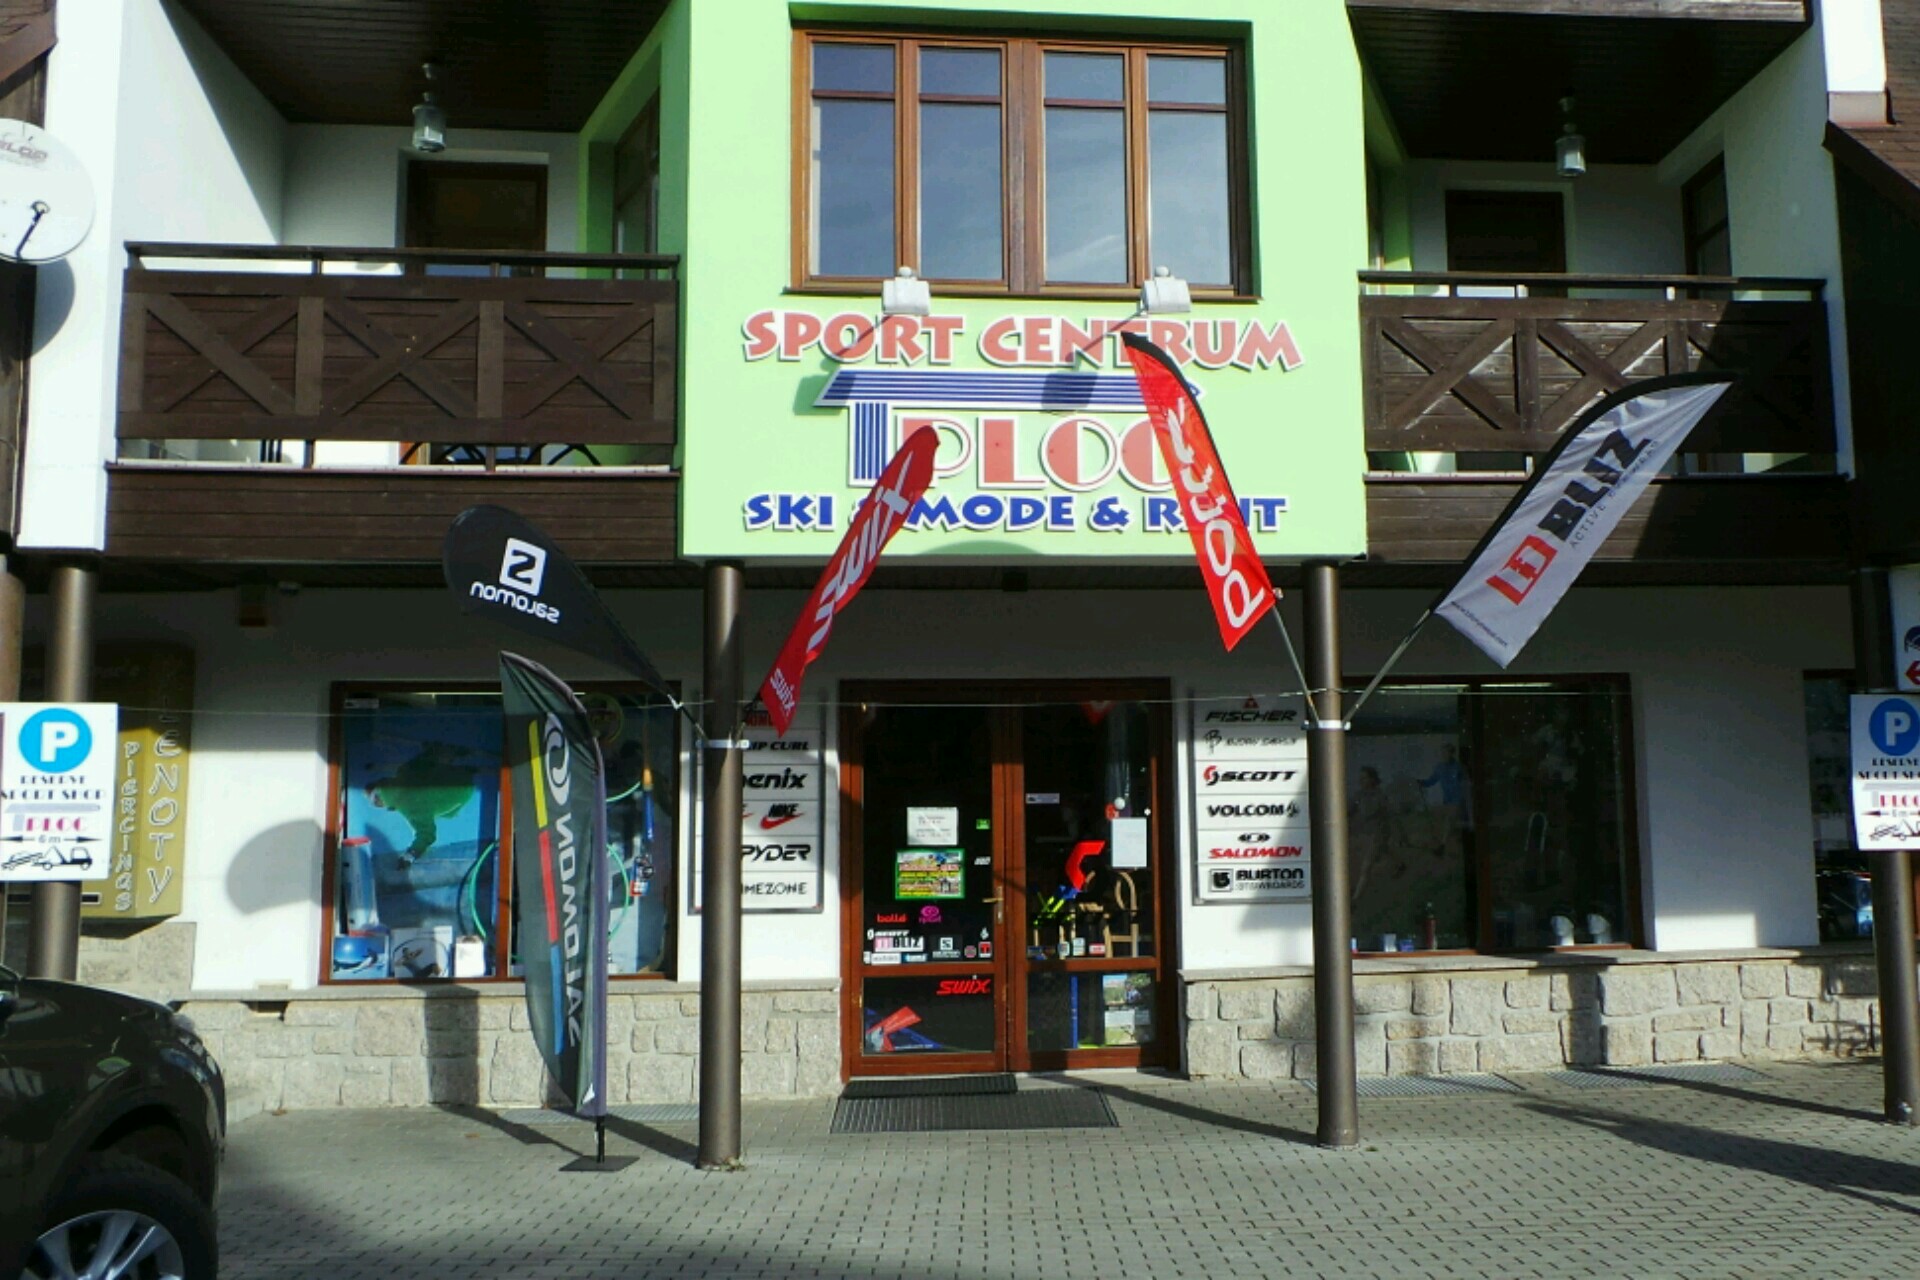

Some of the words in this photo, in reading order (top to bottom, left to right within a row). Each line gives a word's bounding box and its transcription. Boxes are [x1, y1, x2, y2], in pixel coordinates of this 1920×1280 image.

[742, 312, 964, 362] SPORT
[978, 315, 1302, 371] CENTRUM
[744, 494, 836, 530] SKI
[908, 495, 1076, 530] MODE
[1092, 496, 1130, 529] &
[1144, 496, 1288, 530] RT
[1204, 710, 1298, 723] FISCHER
[1884, 711, 1912, 747] P
[40, 721, 80, 763] P
[770, 740, 810, 751] CURL
[1221, 770, 1297, 782] SCOTT
[768, 803, 799, 818] NIKE
[1207, 803, 1284, 818] VOLCOM
[114, 741, 140, 912] PIERCINGS
[742, 844, 811, 862] PYDER
[1208, 846, 1304, 860] SALOMON
[1235, 868, 1305, 882] BURTON
[743, 882, 808, 896] MEZONE
